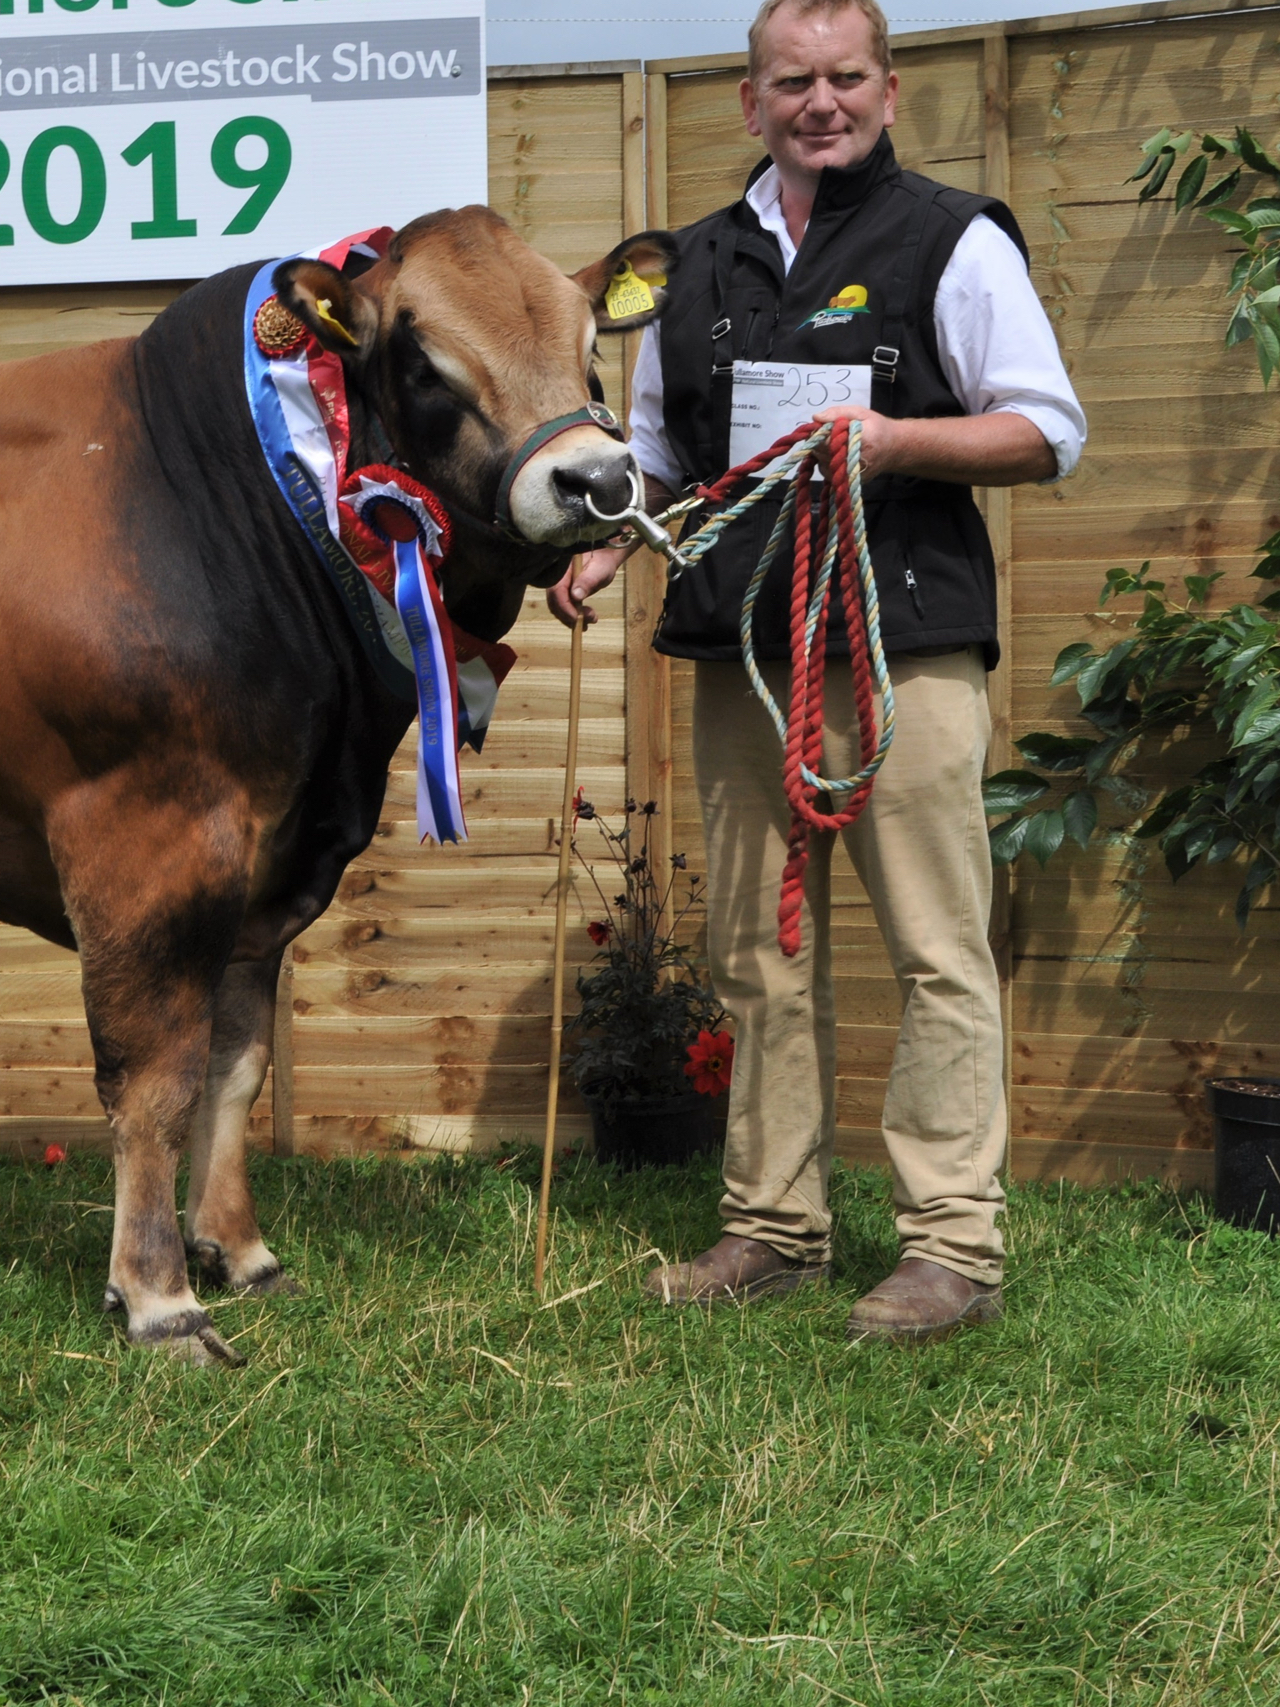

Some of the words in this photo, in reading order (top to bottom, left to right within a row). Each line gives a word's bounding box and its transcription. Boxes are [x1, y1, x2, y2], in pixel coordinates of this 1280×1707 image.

[111, 44, 322, 91] Livestock
[332, 41, 457, 83] Show
[611, 293, 649, 317] 10005
[733, 368, 763, 378] ullamore
[765, 369, 785, 378] Show
[778, 366, 852, 408] 253
[406, 605, 432, 676] TULLAMORE
[421, 676, 437, 714] SHOW
[426, 717, 439, 746] 2019
